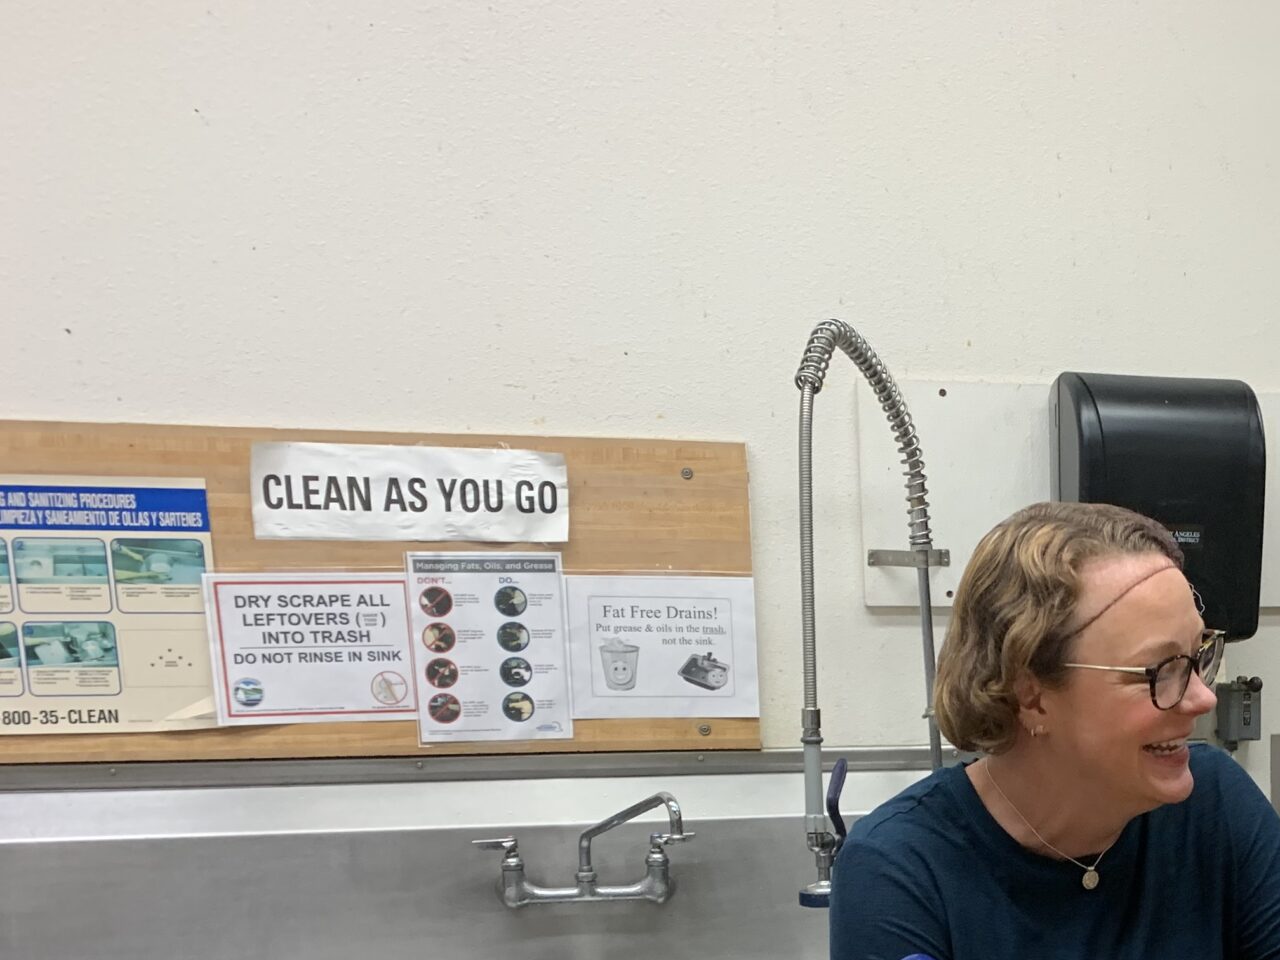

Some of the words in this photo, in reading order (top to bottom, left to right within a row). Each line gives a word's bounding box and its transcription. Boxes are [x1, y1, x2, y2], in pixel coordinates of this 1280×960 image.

[8, 492, 26, 508] AND
[28, 492, 78, 509] SANITIZING
[79, 493, 137, 510] PROCEDURES
[262, 473, 373, 512] CLEAN
[383, 476, 428, 513] AS
[436, 478, 504, 513] YOU
[515, 479, 558, 514] GO
[36, 509, 44, 525] Y
[47, 510, 107, 526] SANEAMIENTO
[109, 511, 122, 526] DE
[122, 511, 150, 527] OLLAS
[152, 512, 159, 527] Y
[159, 512, 203, 528] SARTENES
[416, 562, 459, 571] Managing
[461, 562, 482, 571] Fats,
[484, 562, 502, 571] Oils,
[505, 562, 521, 570] and
[523, 562, 553, 571] Grease
[233, 595, 272, 609] DRY
[277, 594, 351, 608] SCRAPE
[356, 593, 390, 608] ALL
[242, 613, 350, 627] LEFTOVERS
[602, 605, 625, 619] Fat
[630, 605, 662, 619] Free
[666, 605, 718, 620] Drains!
[595, 623, 611, 633] Put
[613, 625, 642, 635] grease
[644, 624, 654, 633] &
[656, 623, 672, 633] oils
[675, 624, 684, 633] in
[686, 624, 700, 633] the
[262, 631, 305, 645] INTO
[309, 630, 371, 644] TRASH
[661, 637, 676, 646] not
[679, 637, 693, 646] the
[233, 653, 257, 665] DO
[261, 653, 293, 664] NOT
[298, 652, 344, 664] RINSE
[348, 651, 362, 663] IN
[367, 650, 402, 662] SINK
[2, 708, 119, 726] 800-35-CLEAN
